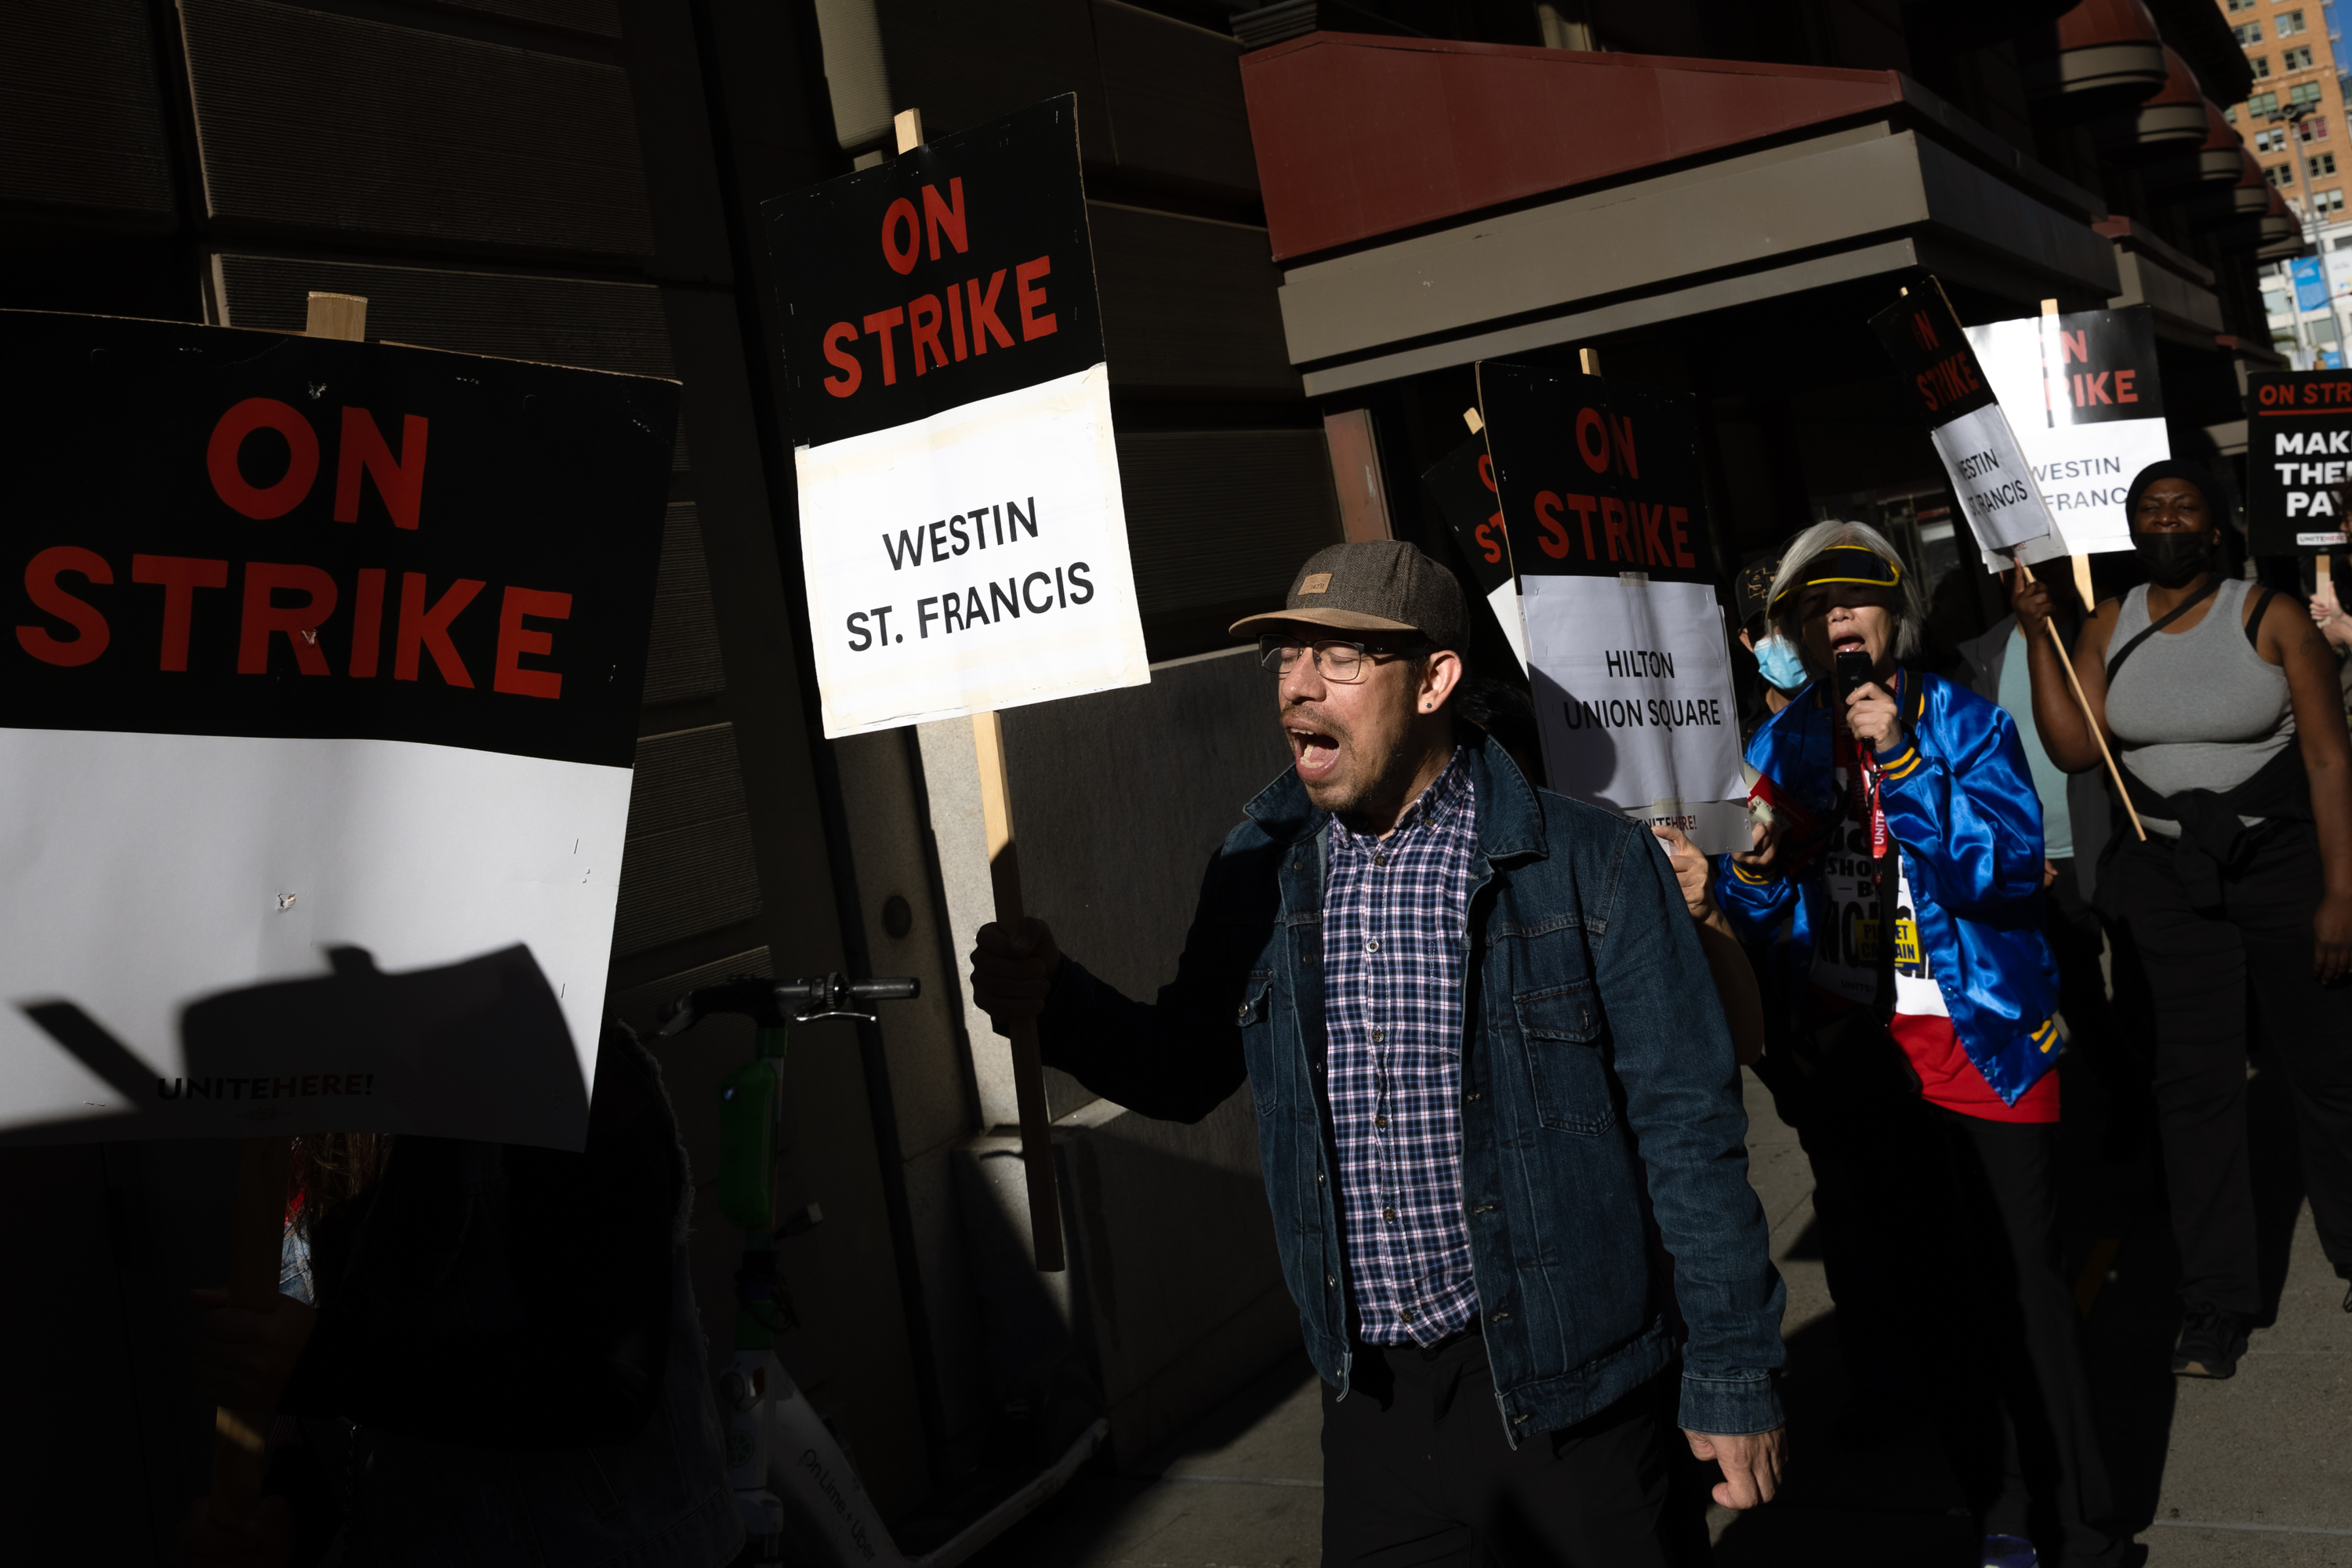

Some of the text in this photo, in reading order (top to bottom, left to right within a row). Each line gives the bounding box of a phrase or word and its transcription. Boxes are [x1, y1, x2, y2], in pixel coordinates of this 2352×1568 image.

[881, 176, 969, 275] ON
[822, 255, 1058, 398] STRIKE
[1916, 350, 1980, 412] STRIKE
[2259, 382, 2352, 406] ON STR
[206, 397, 428, 530] ON
[1576, 407, 1639, 480] ON
[1960, 448, 2000, 480] ESTIN
[2275, 430, 2352, 456] MAK
[1534, 491, 1696, 569] STRIKE
[2042, 487, 2128, 511] FRANC
[882, 496, 1039, 571] WESTIN
[16, 545, 573, 699] STRIKE
[846, 561, 1094, 652] ST. FRANCIS
[1606, 650, 1675, 679] HILTON
[1564, 699, 1721, 731] UNION SQUARE
[1644, 815, 1697, 830] NITEHERE!
[1827, 857, 1871, 877] SHO
[157, 1073, 374, 1101] UNITEHERE!
[819, 1471, 846, 1514] Lime
[851, 1519, 876, 1562] Uber
